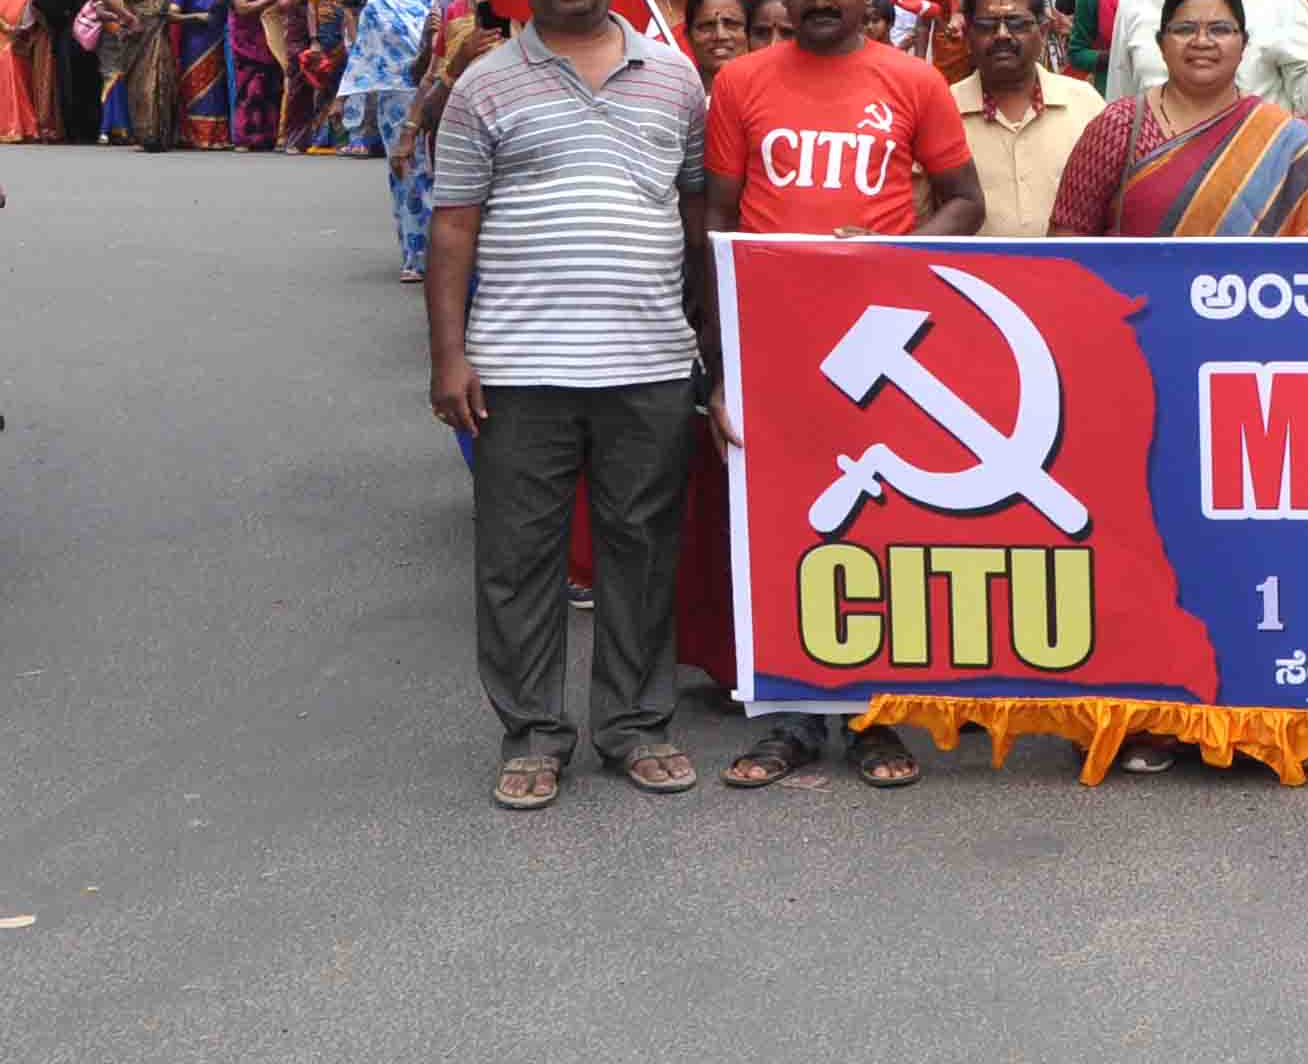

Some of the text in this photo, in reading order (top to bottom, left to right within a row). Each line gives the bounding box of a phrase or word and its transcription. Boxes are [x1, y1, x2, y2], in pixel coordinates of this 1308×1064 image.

[760, 126, 896, 196] CITU
[798, 542, 1094, 671] CITU
[1255, 575, 1285, 632] 1
